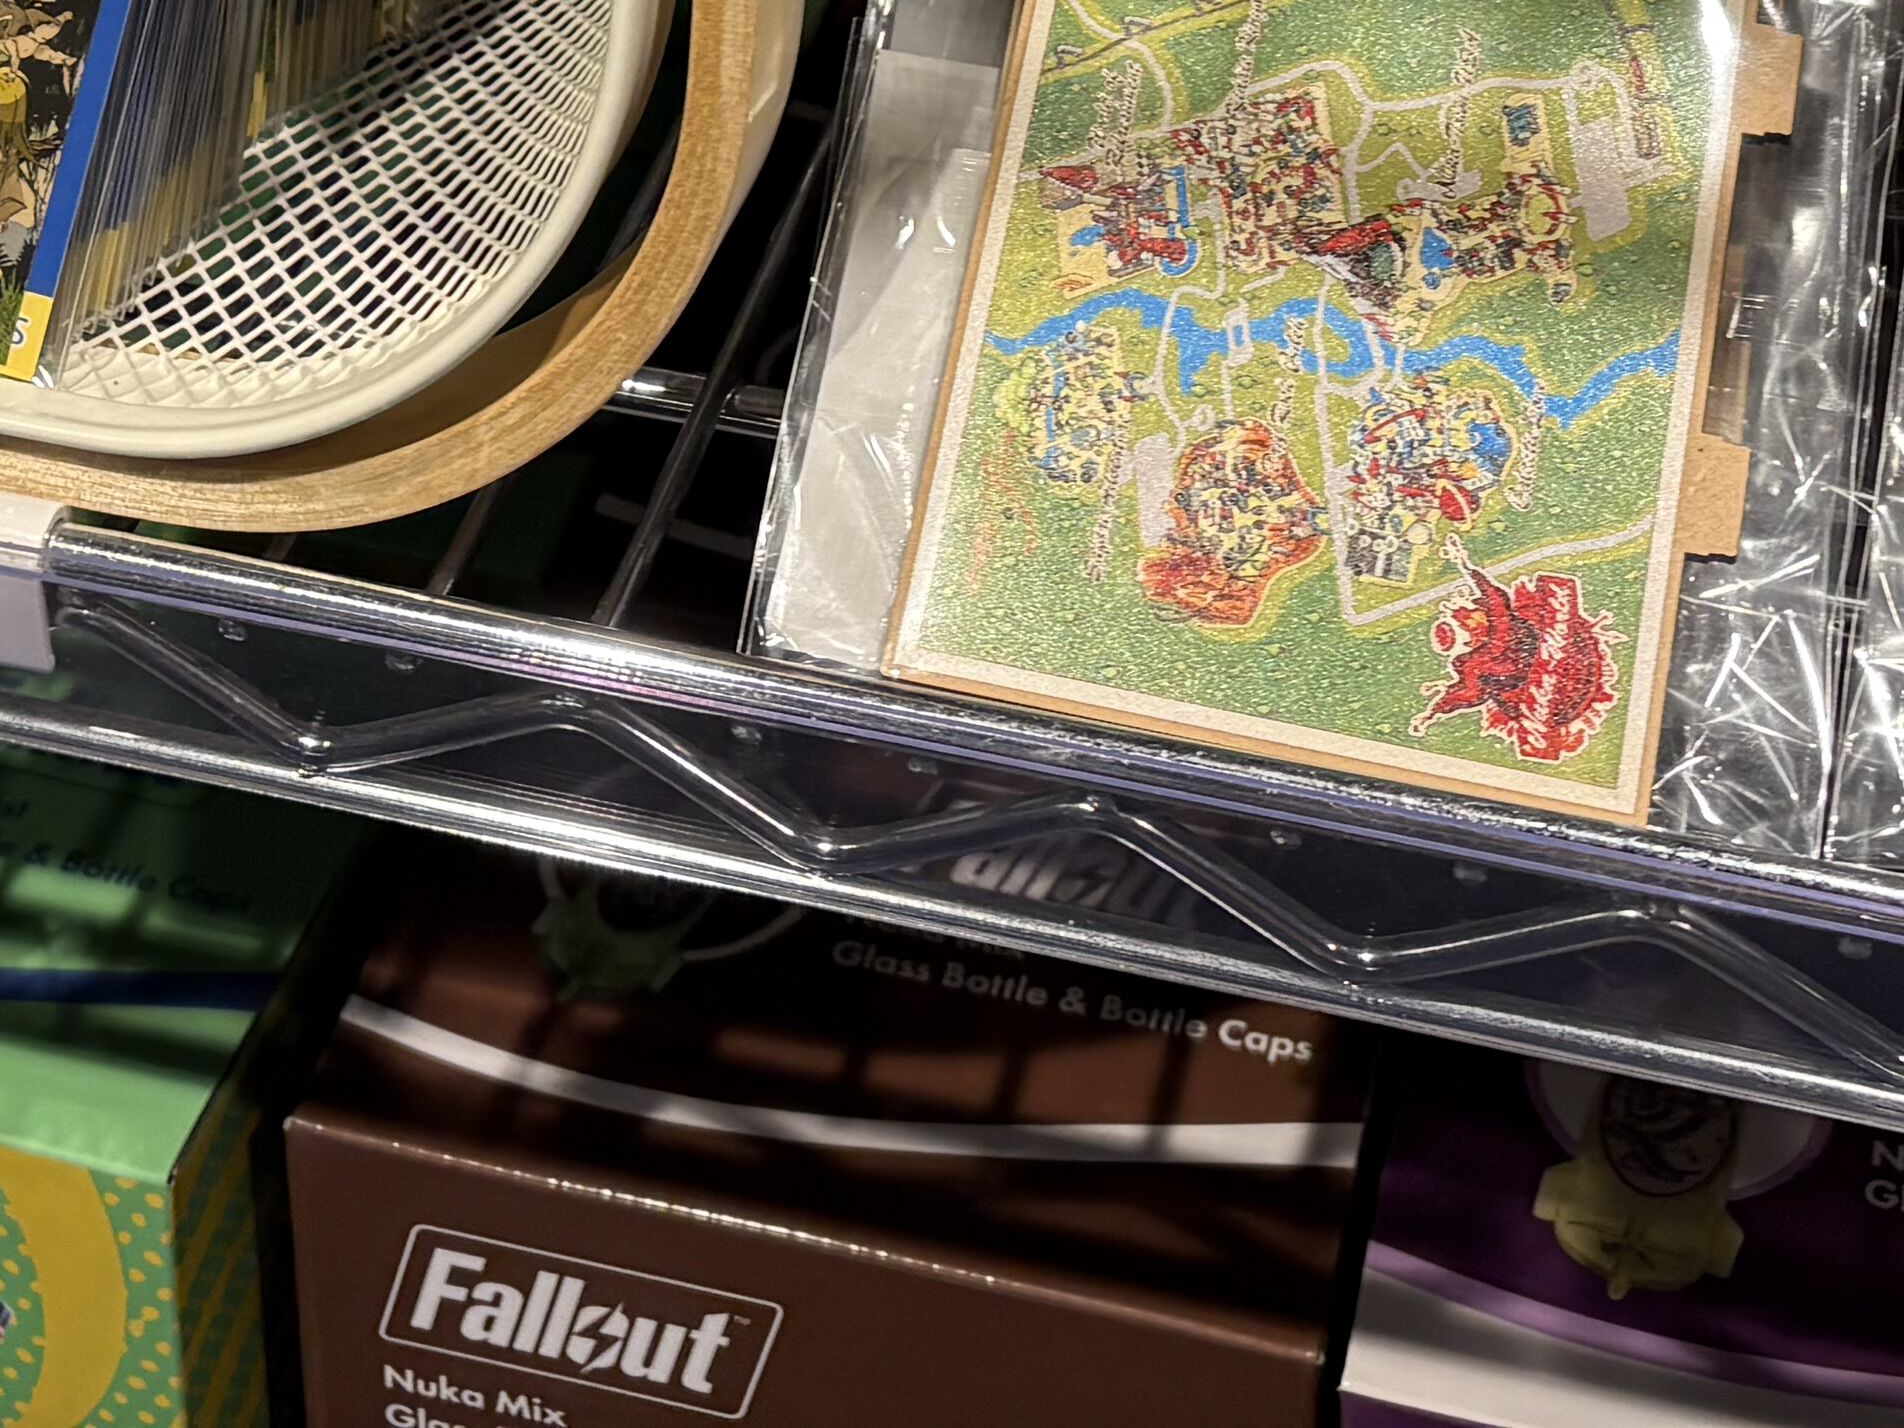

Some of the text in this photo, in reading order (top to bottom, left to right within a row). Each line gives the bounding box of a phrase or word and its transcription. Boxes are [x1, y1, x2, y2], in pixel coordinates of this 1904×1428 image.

[831, 938, 1314, 1066] Glass Bottle & Bottle Caps
[409, 1246, 731, 1395] Fallout
[381, 1363, 572, 1428] Nuka Mix
